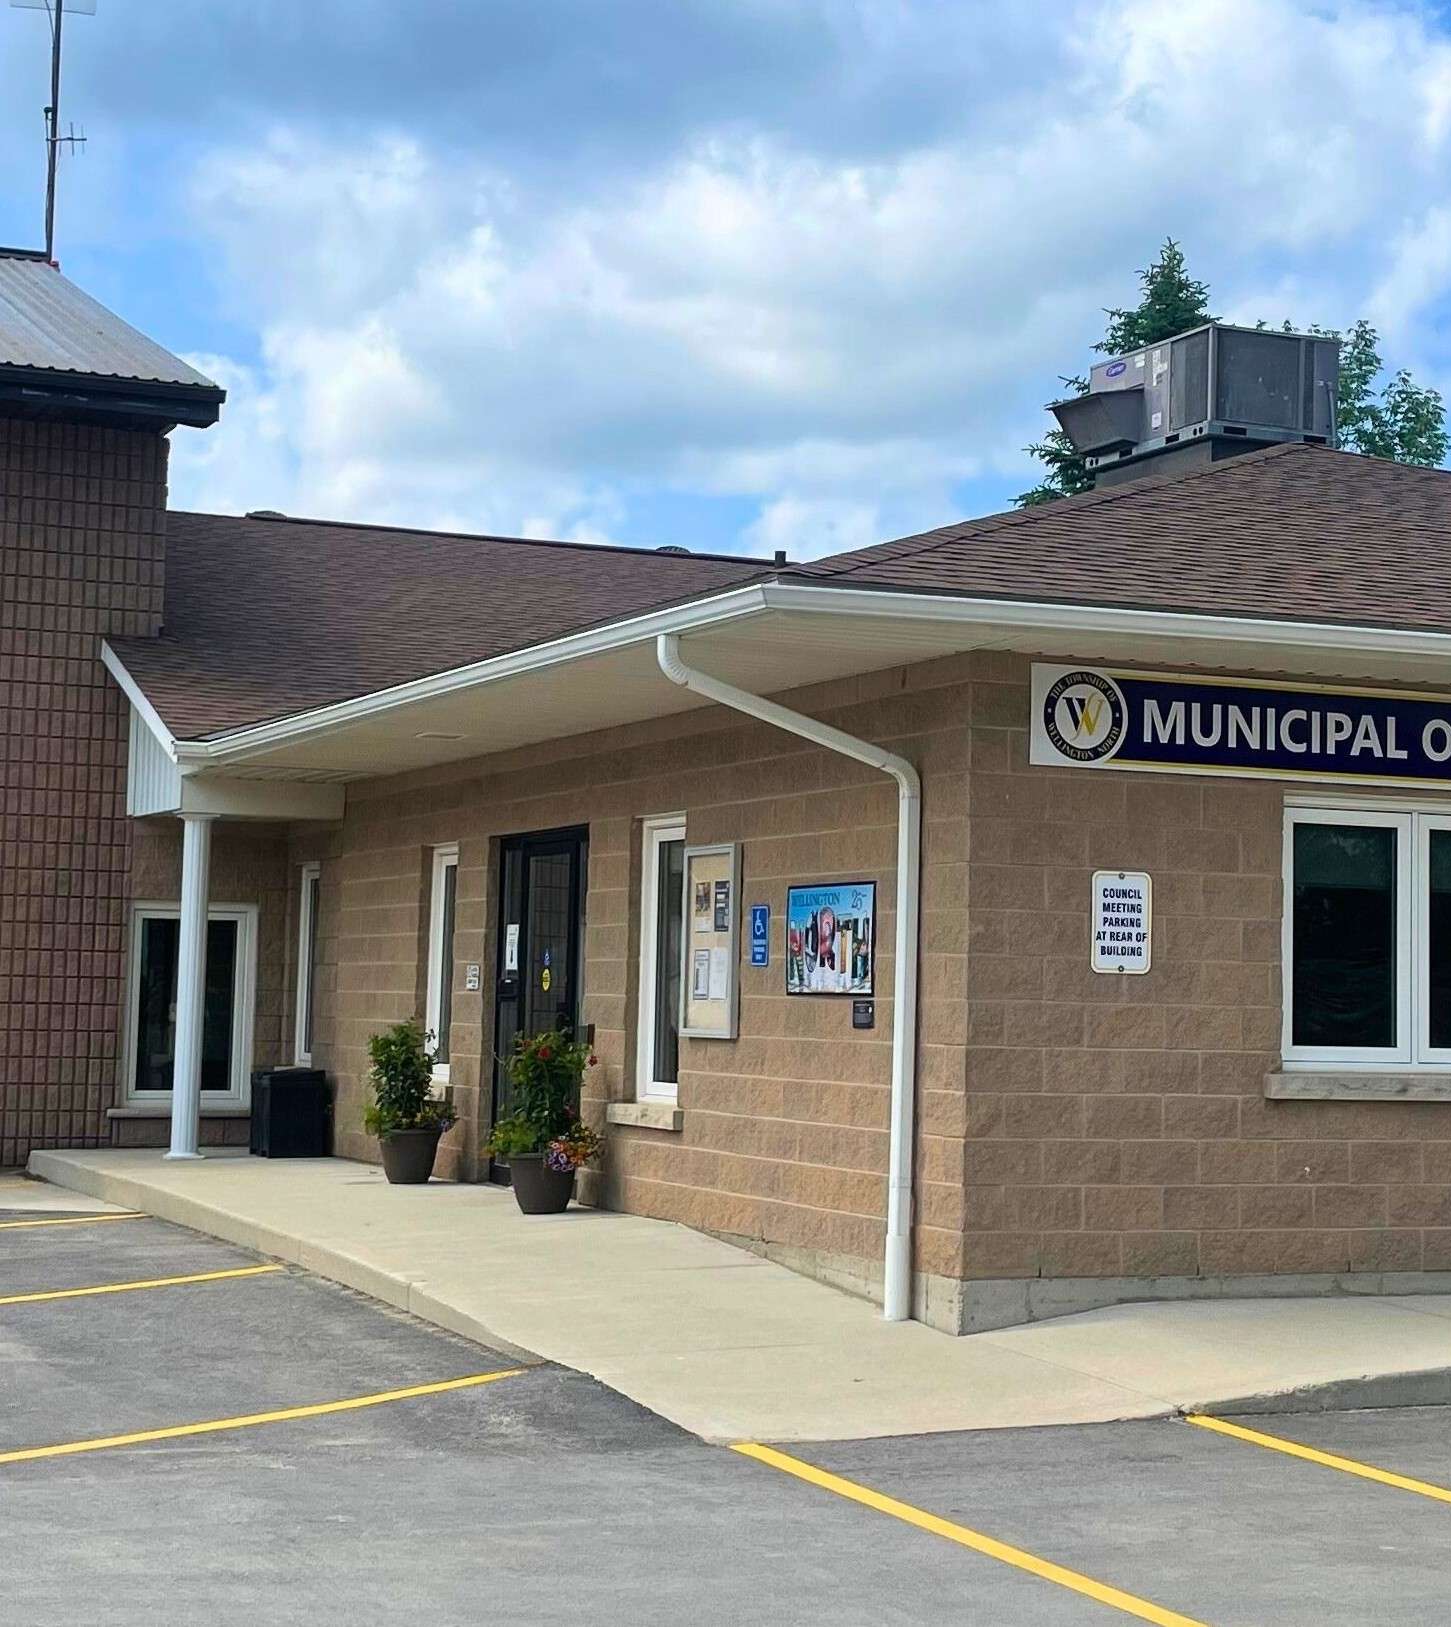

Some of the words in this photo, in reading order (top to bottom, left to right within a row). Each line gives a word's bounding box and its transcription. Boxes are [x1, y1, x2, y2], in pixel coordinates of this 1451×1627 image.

[1143, 698, 1408, 760] MUNICIPAL
[1096, 726, 1120, 753] NORTH
[1102, 888, 1142, 899] COUNCIL
[1102, 902, 1142, 914] MEETING
[1102, 917, 1142, 928] PARKING
[1096, 931, 1107, 941] AT
[1109, 931, 1133, 942] REAR
[1135, 932, 1149, 943] OF
[1100, 945, 1142, 957] BUILDING
